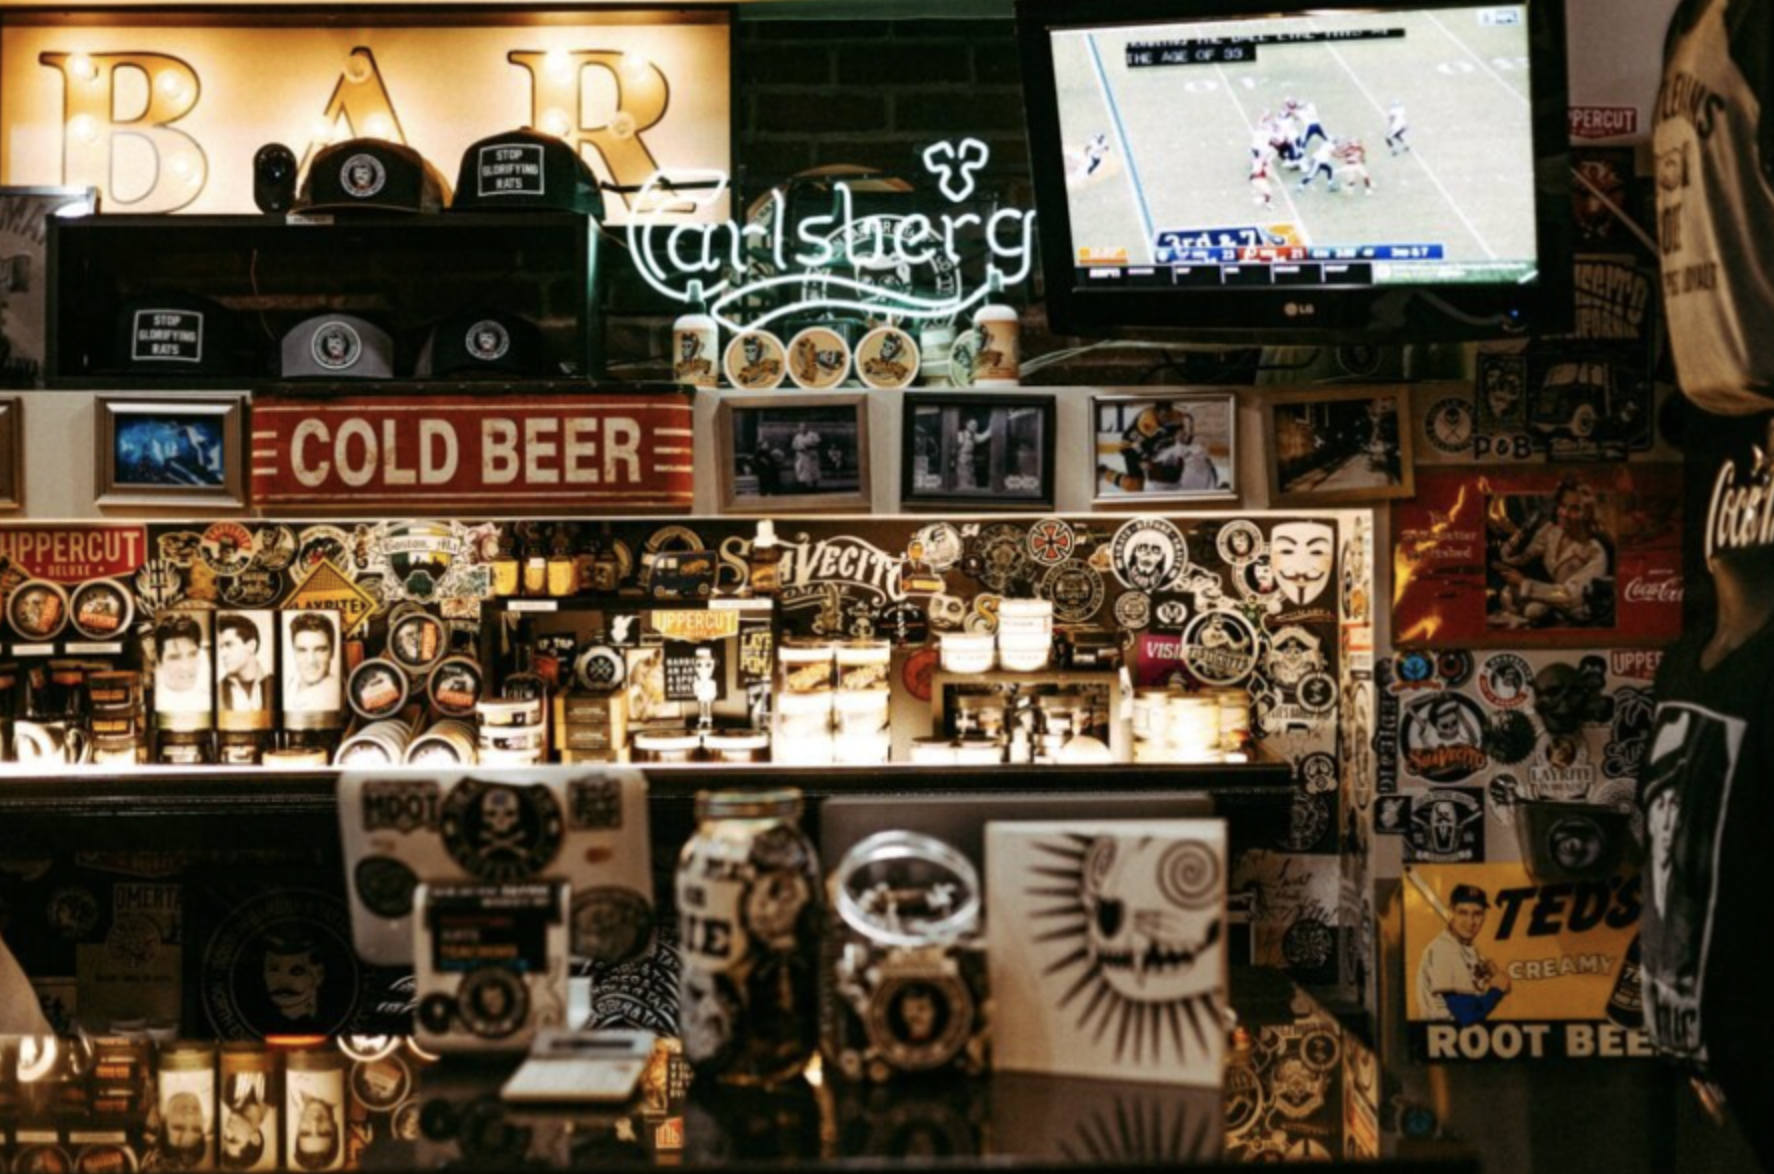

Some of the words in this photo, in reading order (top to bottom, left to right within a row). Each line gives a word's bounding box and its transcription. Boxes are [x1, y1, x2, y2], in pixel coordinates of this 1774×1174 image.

[39, 46, 696, 215] BAR
[495, 149, 523, 161] STOP
[495, 177, 523, 189] RATS
[627, 169, 1037, 301] Carlsberg
[153, 314, 182, 327] STOP
[137, 329, 197, 343] GLORIFYING
[151, 343, 181, 356] RATS
[290, 418, 459, 488] COLD
[482, 418, 643, 488] BEER
[658, 611, 735, 631] UPPERCUT
[1508, 955, 1618, 979] CREAMY
[1428, 1024, 1549, 1057] ROOT
[1566, 1024, 1660, 1057] BEE
